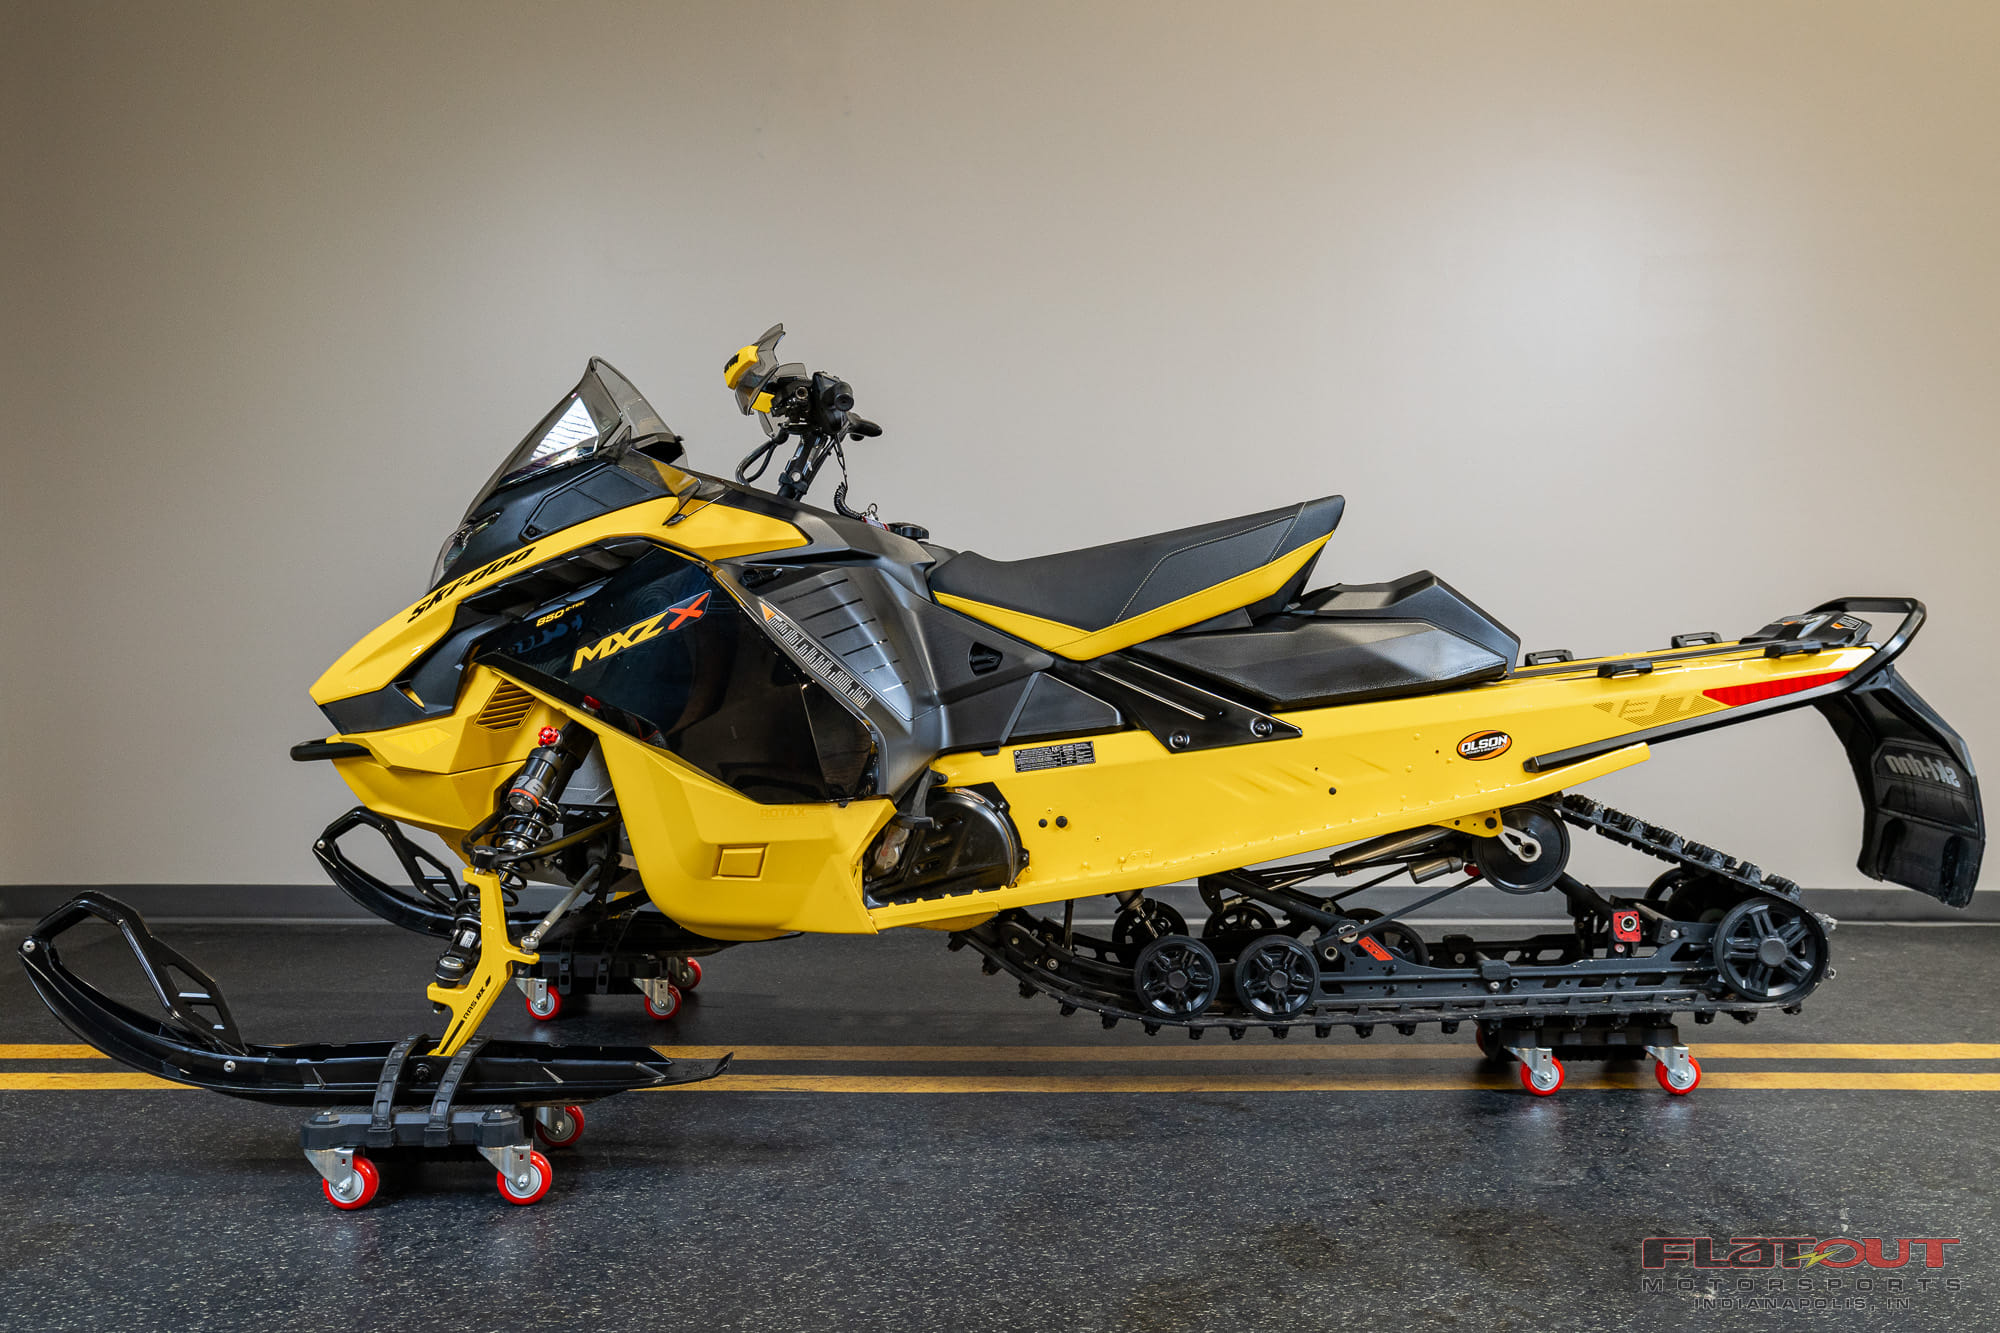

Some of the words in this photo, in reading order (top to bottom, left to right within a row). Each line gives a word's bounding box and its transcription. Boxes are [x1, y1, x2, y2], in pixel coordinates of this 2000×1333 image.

[536, 609, 564, 627] 850
[571, 611, 669, 672] MXZ
[667, 592, 710, 630] X
[461, 735, 508, 753] OLSON
